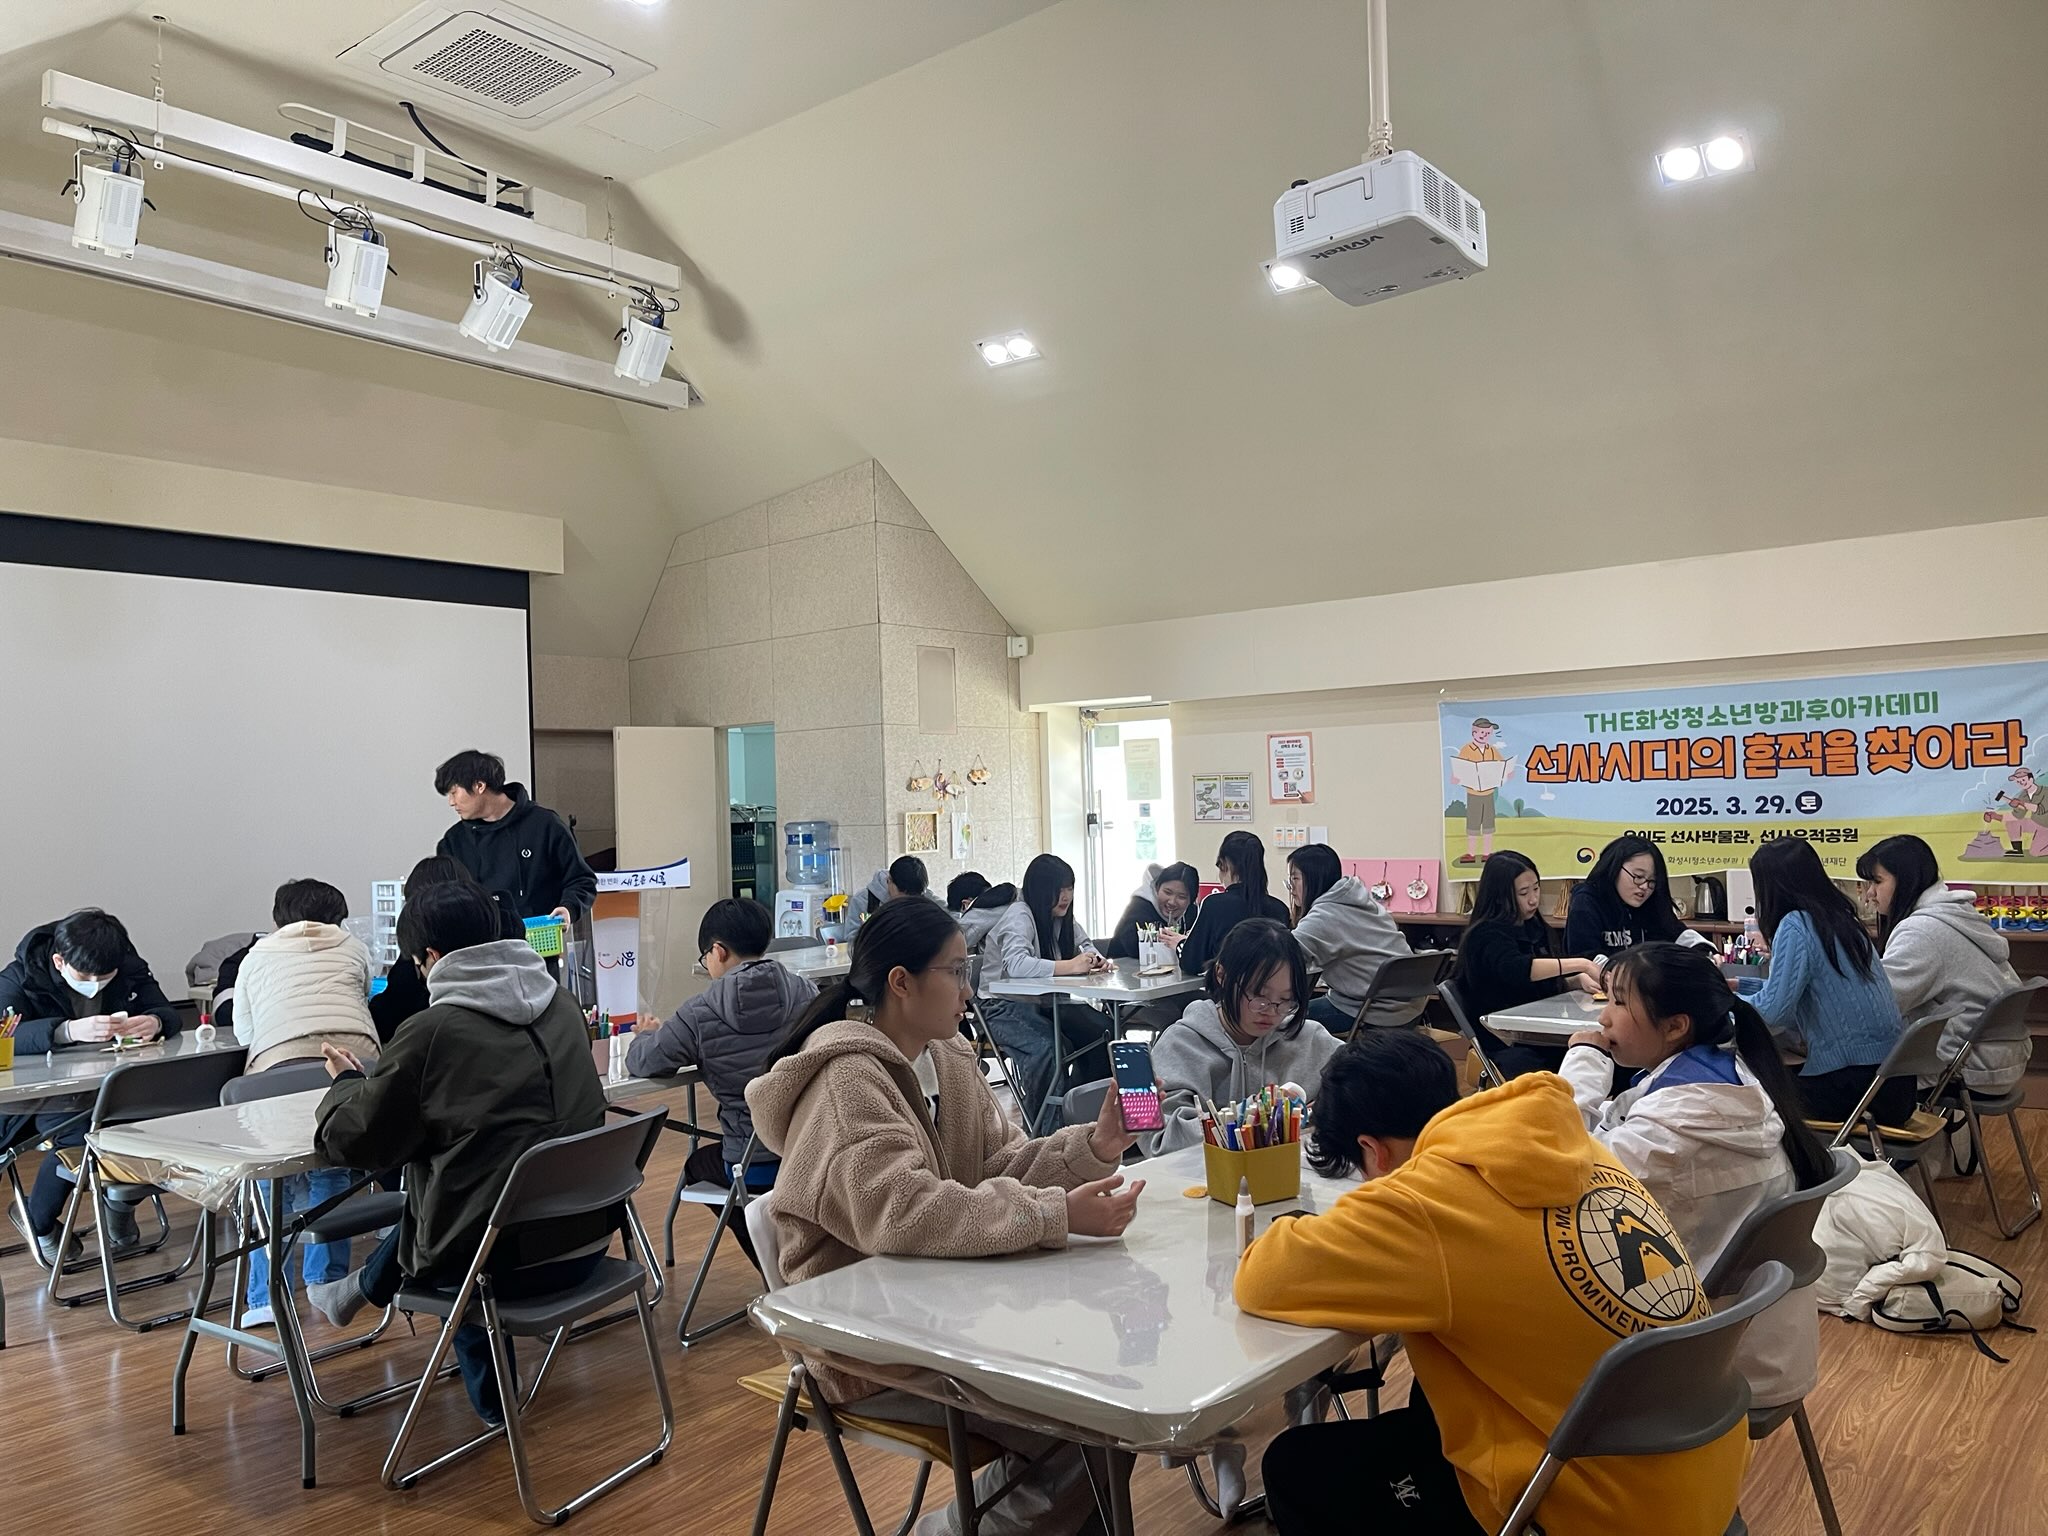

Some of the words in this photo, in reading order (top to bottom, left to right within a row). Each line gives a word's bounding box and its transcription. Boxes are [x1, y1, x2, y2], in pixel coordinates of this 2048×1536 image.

[1584, 691, 1939, 733] THE화성청소년방과후아카데미
[1525, 735, 1736, 784] 선사시대의
[1743, 727, 1858, 779] 흔적을
[1865, 719, 2028, 775] 찾아라
[1656, 798, 1719, 816] 2025.
[1726, 797, 1747, 815] 3.
[1755, 795, 1791, 815] 29.
[1671, 829, 1754, 844] 선사박물관,
[621, 874, 646, 887] 새로운
